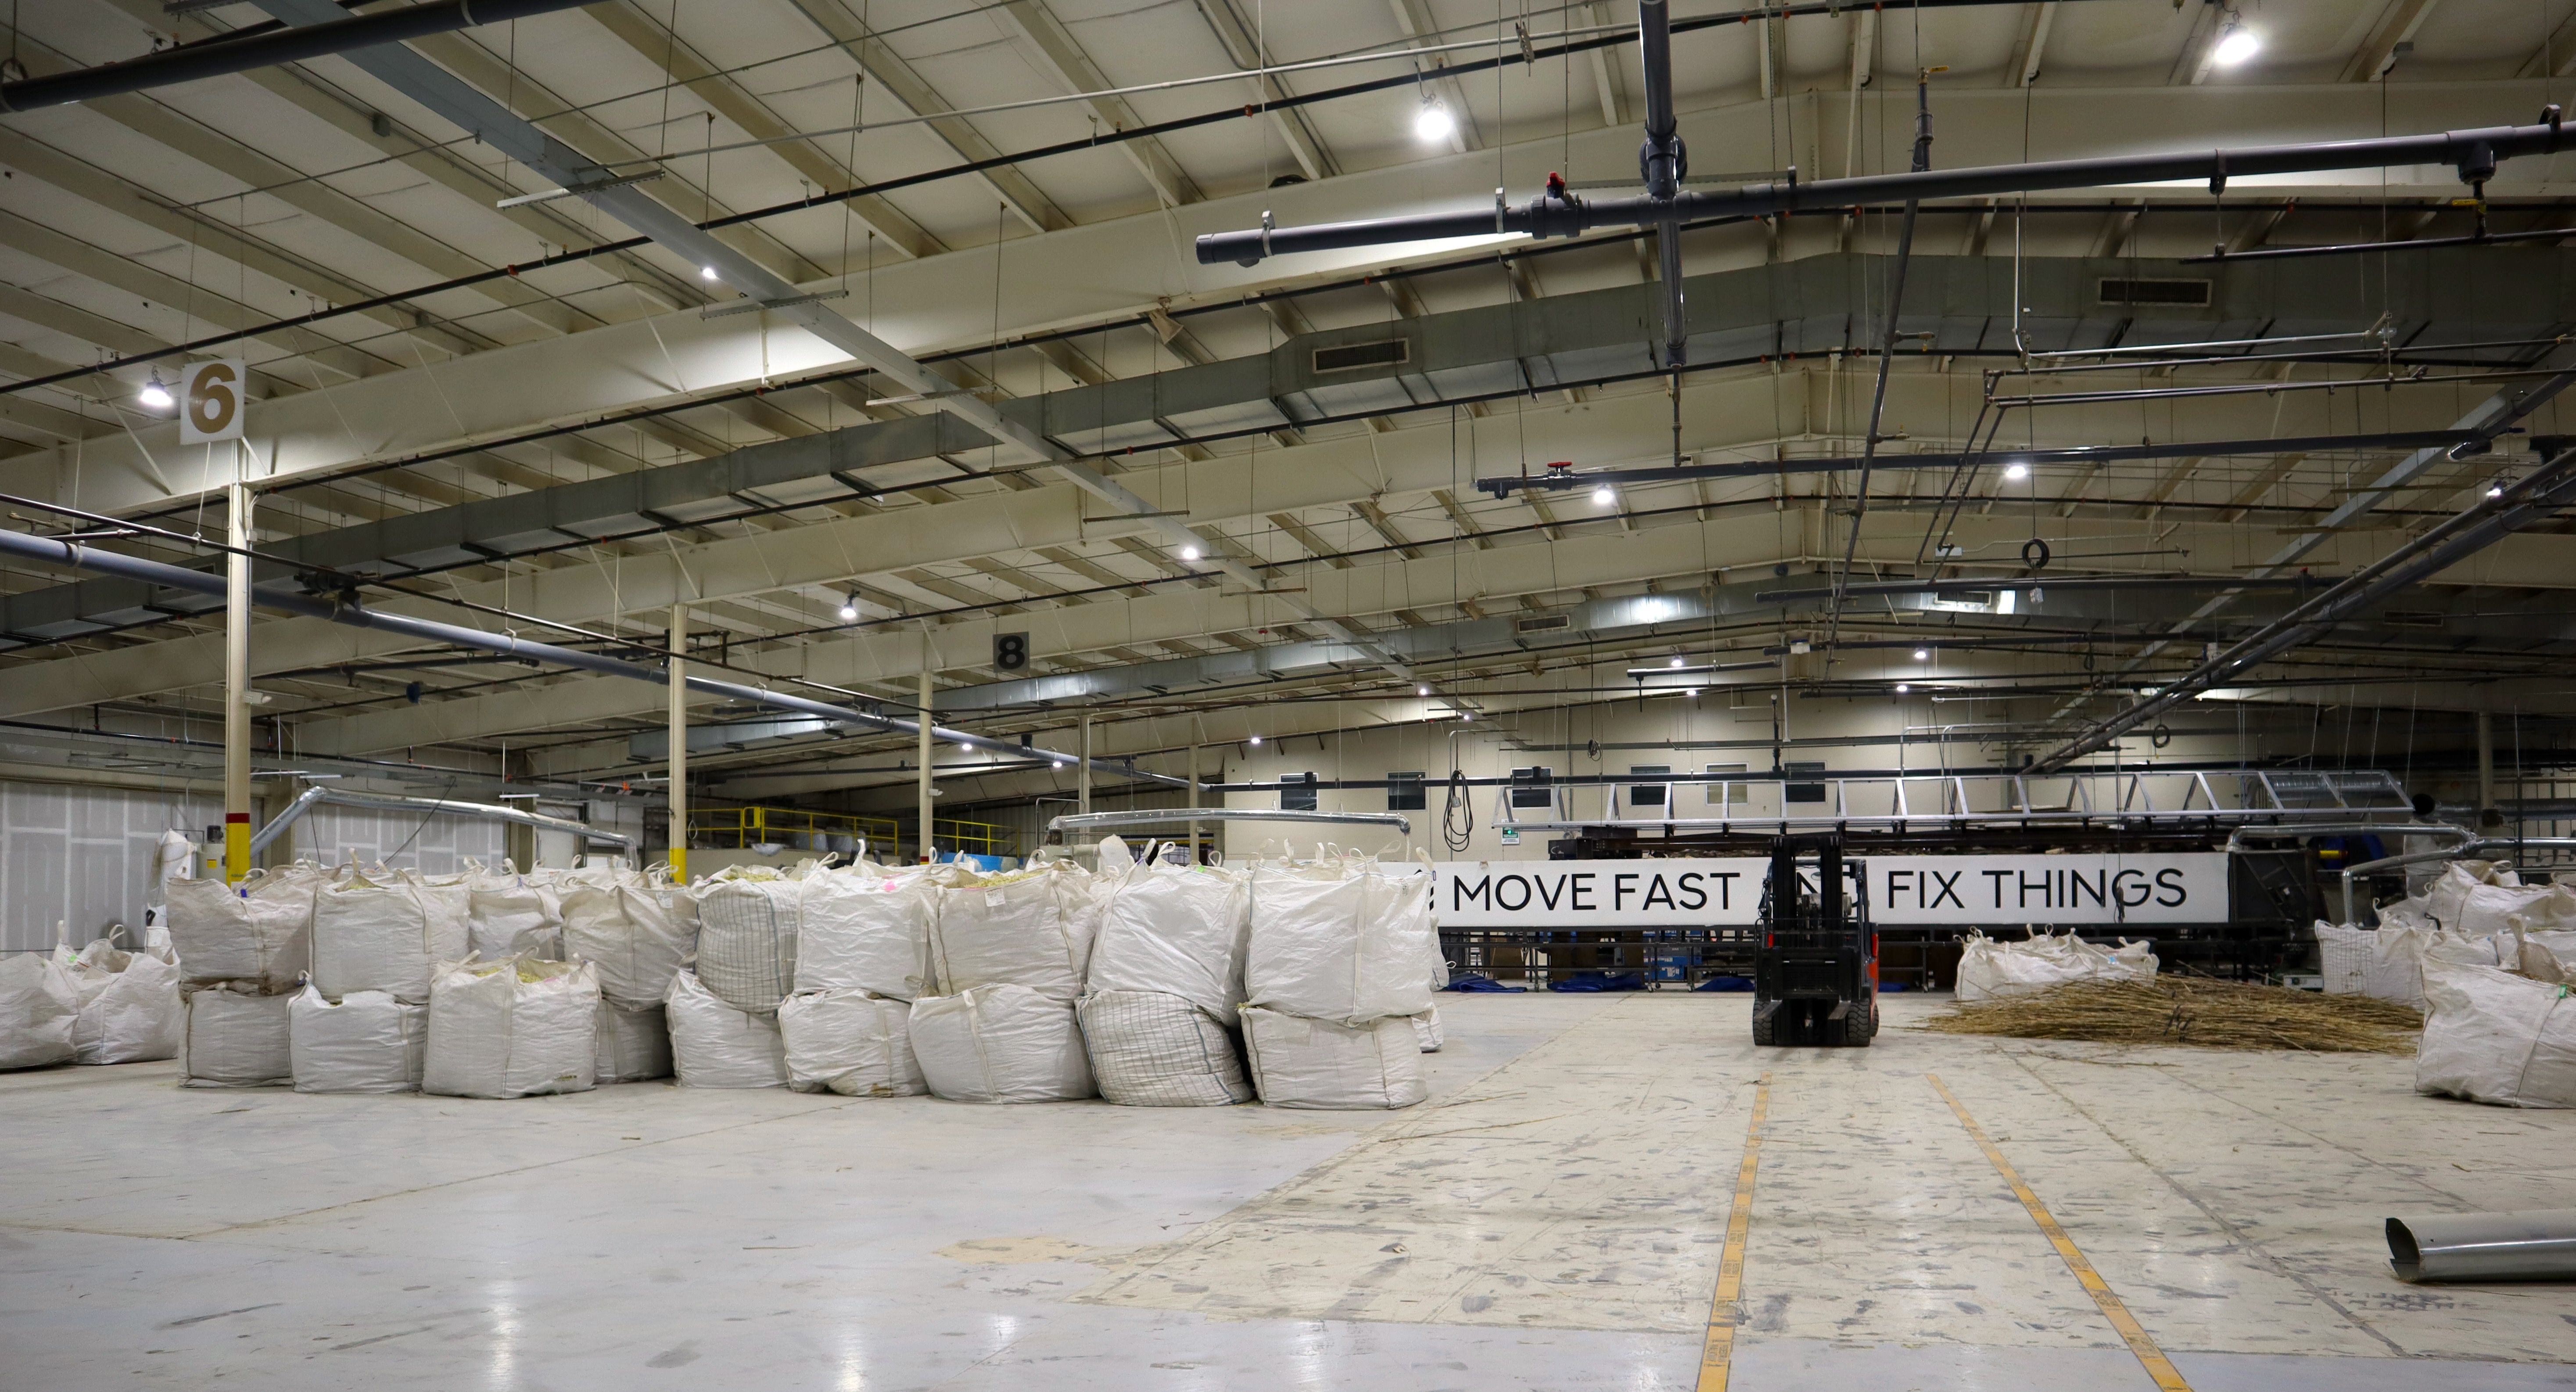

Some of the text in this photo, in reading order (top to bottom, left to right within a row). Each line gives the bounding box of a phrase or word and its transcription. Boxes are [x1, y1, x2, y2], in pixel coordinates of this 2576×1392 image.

[188, 363, 237, 434] 6
[997, 635, 1025, 670] 8
[1454, 873, 1597, 911] MOVE
[1615, 872, 1740, 911] FAST
[1888, 870, 1965, 909] FIX
[1982, 868, 2187, 909] THINGS
